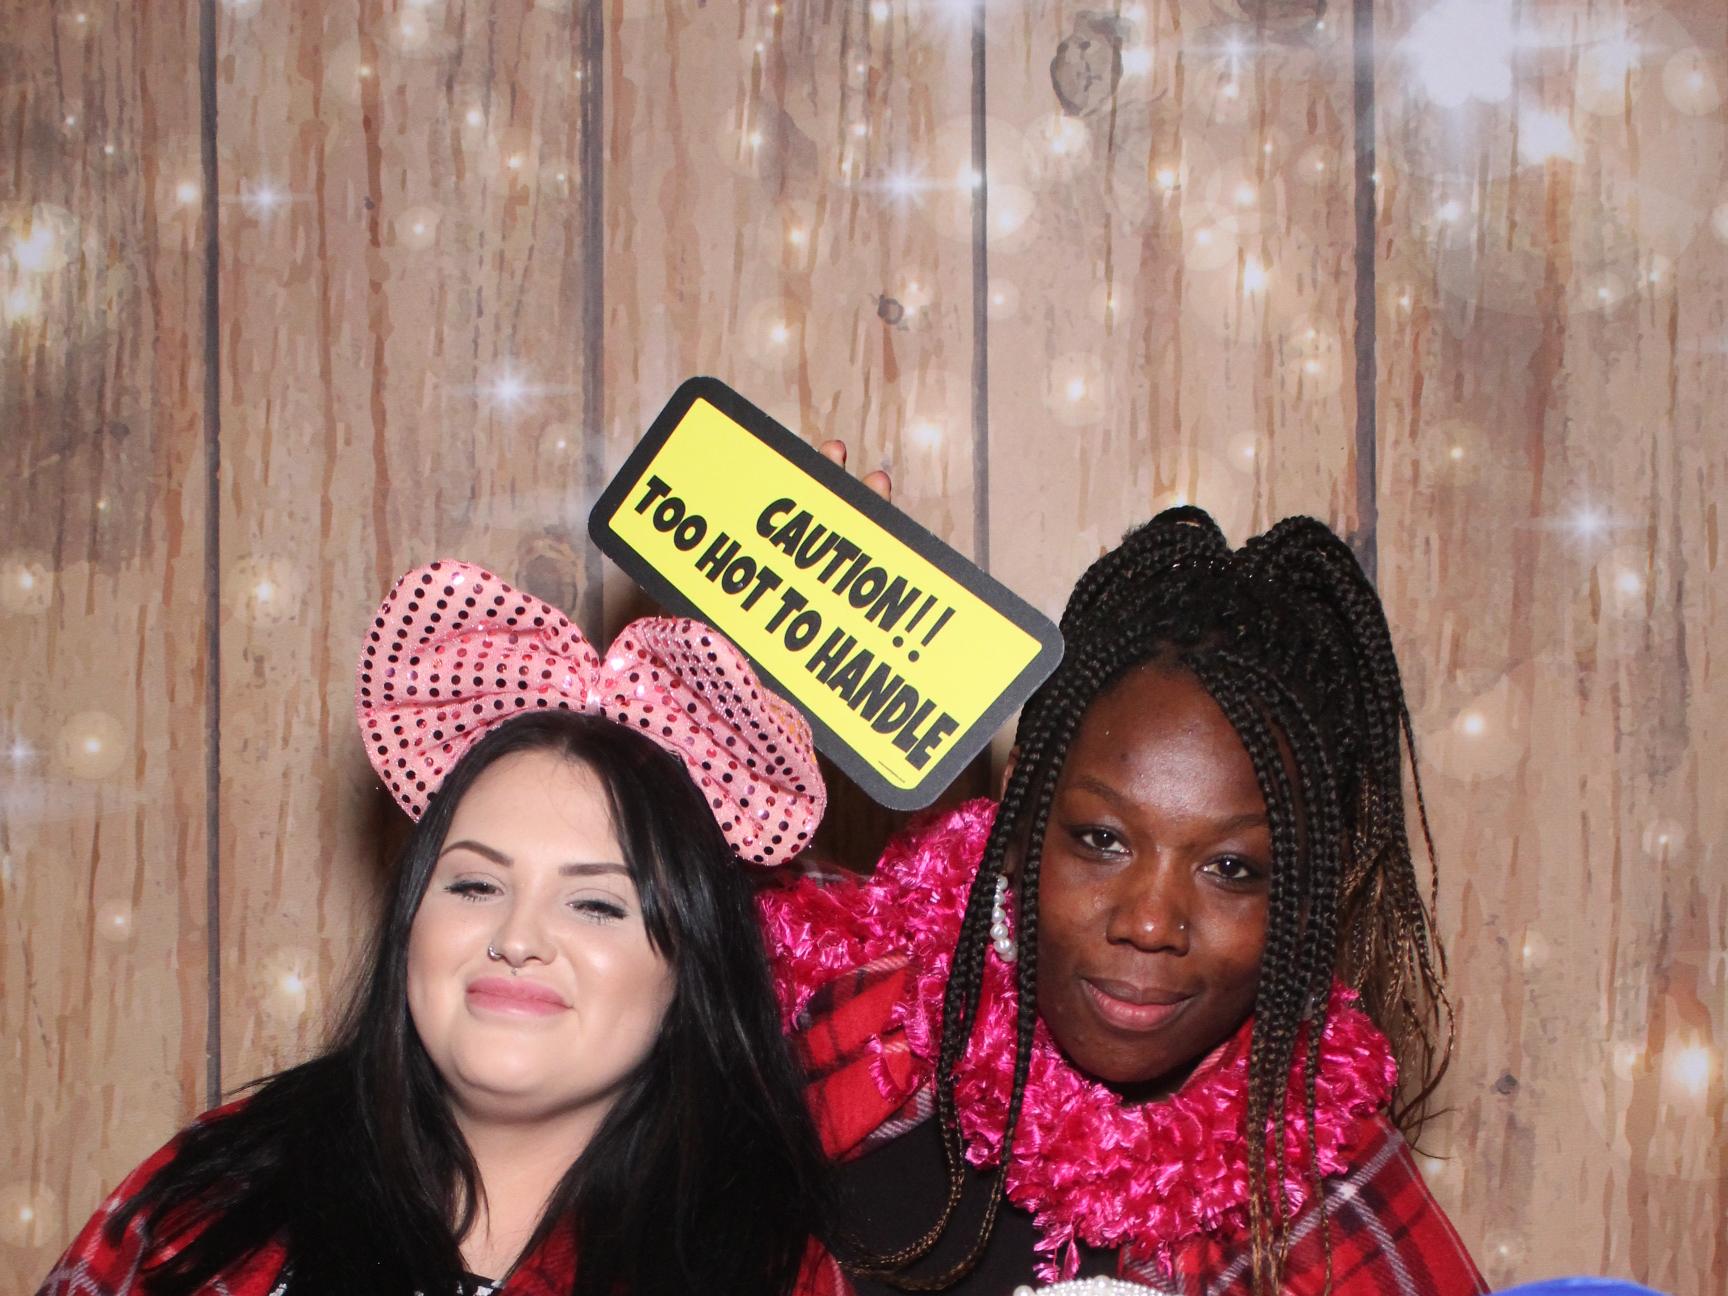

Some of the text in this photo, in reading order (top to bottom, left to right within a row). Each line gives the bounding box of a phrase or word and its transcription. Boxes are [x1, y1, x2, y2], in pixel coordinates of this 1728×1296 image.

[633, 473, 961, 772] TOO HOT TO HANDLE
[755, 496, 957, 663] CAUTION!!
